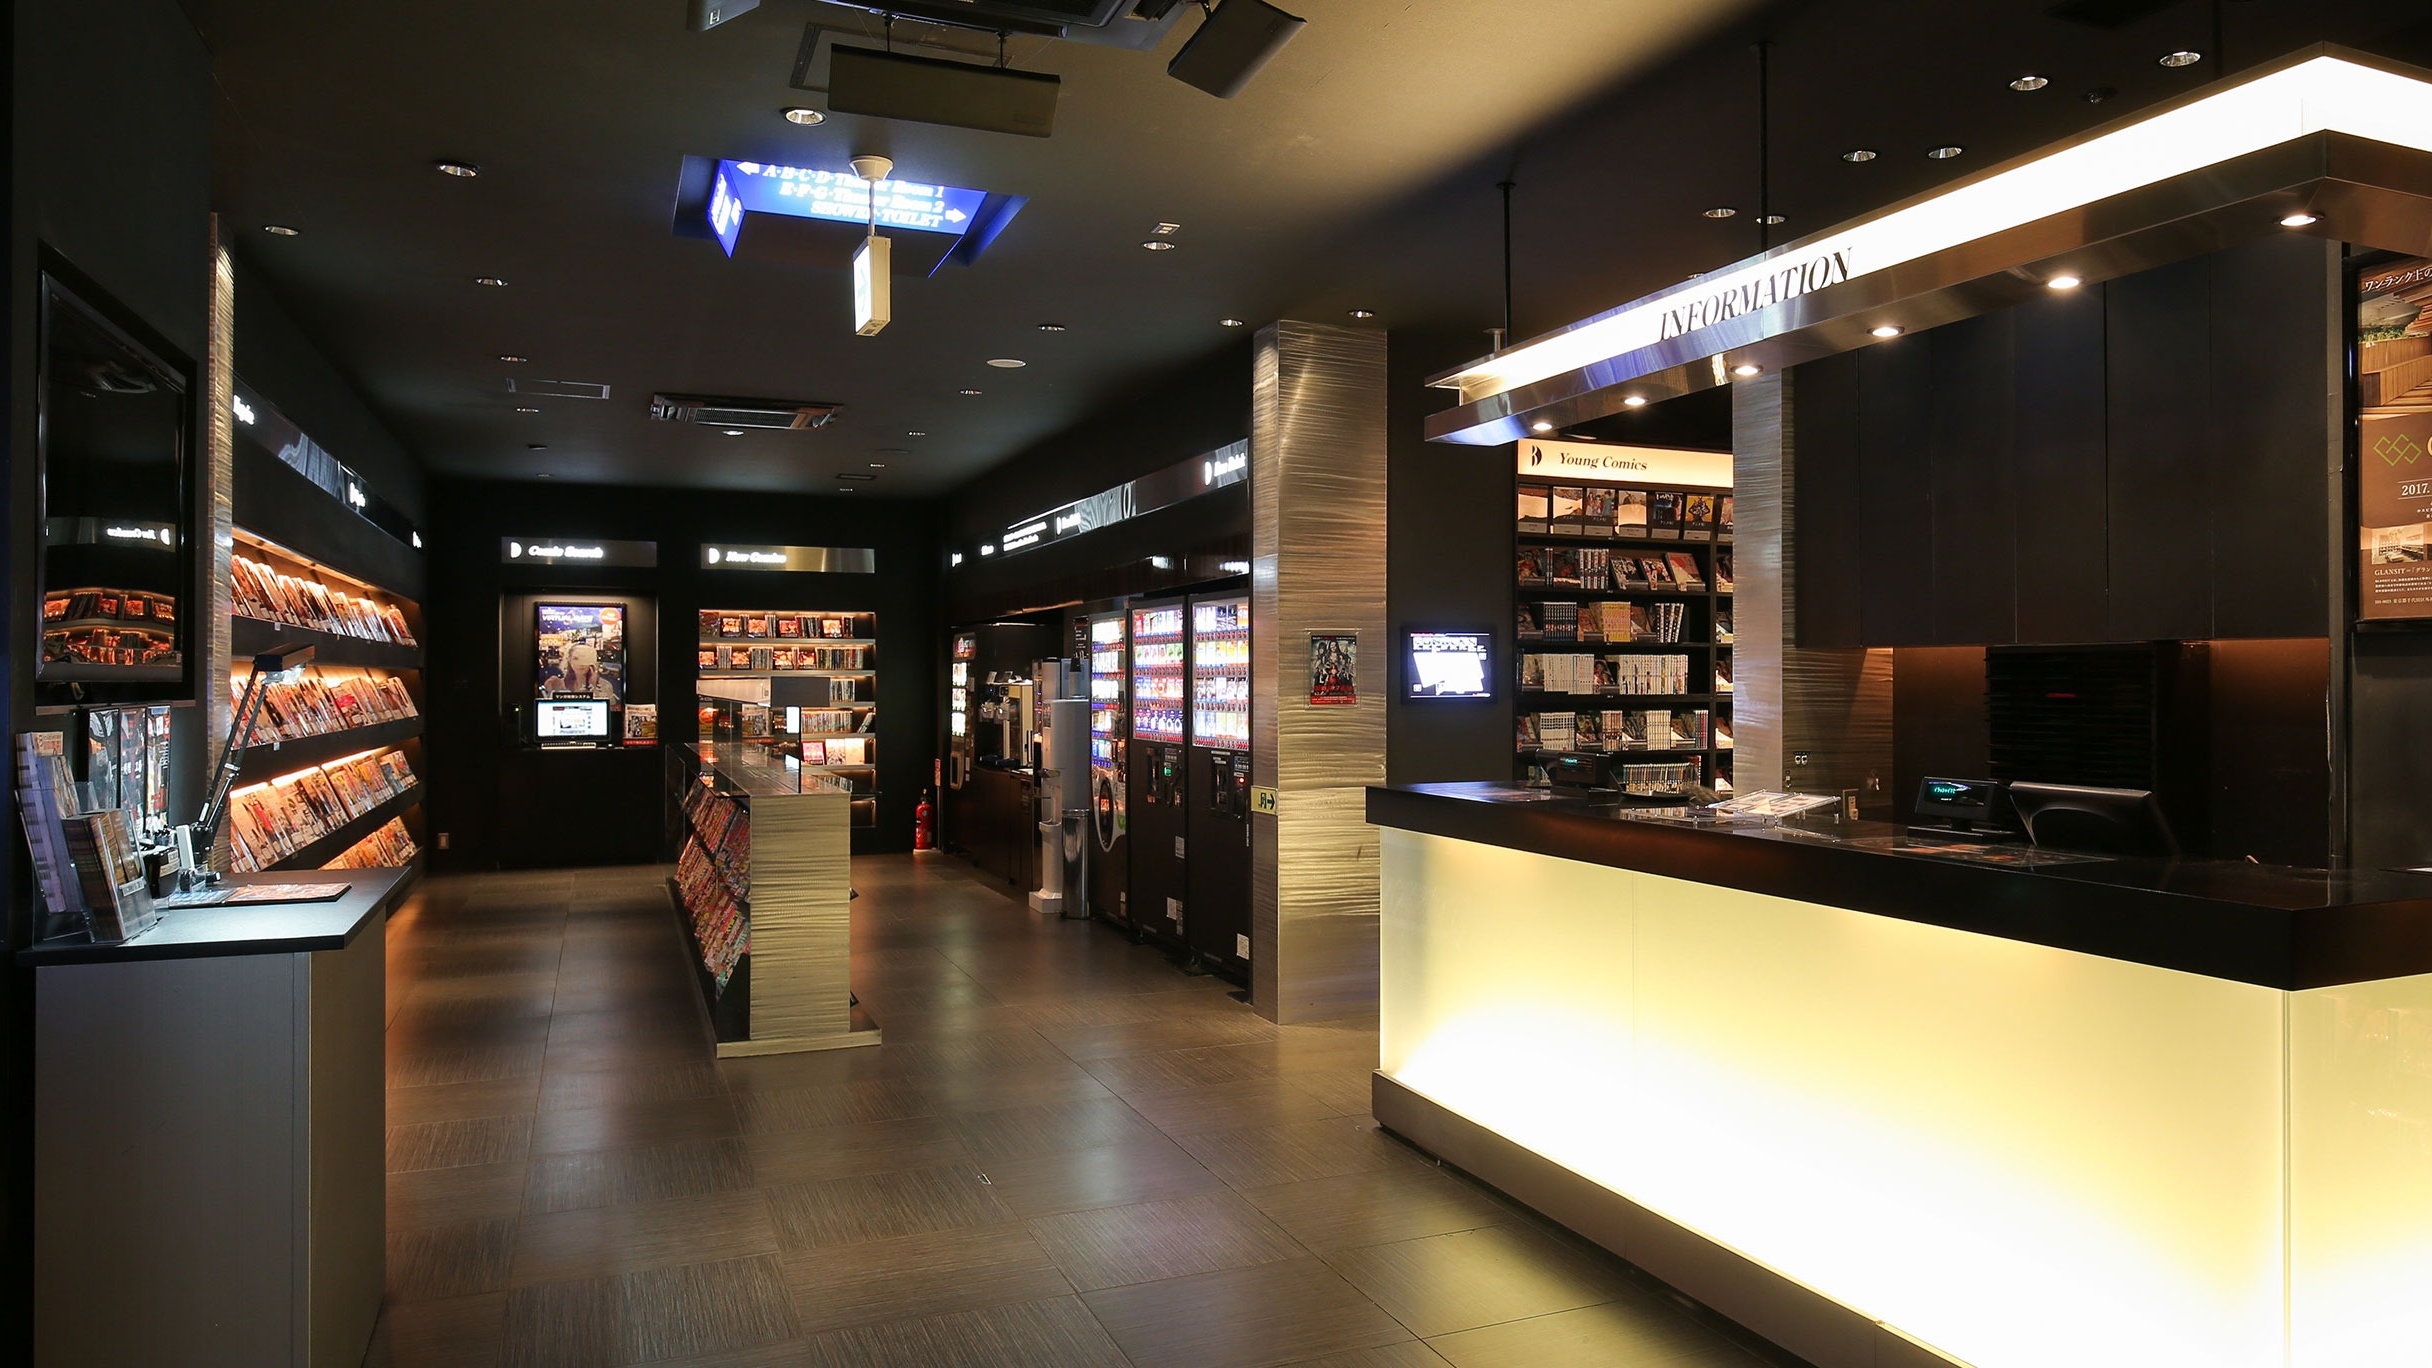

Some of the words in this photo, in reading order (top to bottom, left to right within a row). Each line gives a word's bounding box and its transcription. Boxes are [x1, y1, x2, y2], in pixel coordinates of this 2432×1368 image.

[935, 186, 944, 198] 1
[933, 201, 945, 213] 2
[1660, 247, 1853, 341] INFORMATION
[1560, 452, 1600, 469] Young
[1602, 455, 1648, 471] Comics
[2401, 482, 2430, 496] 2017.
